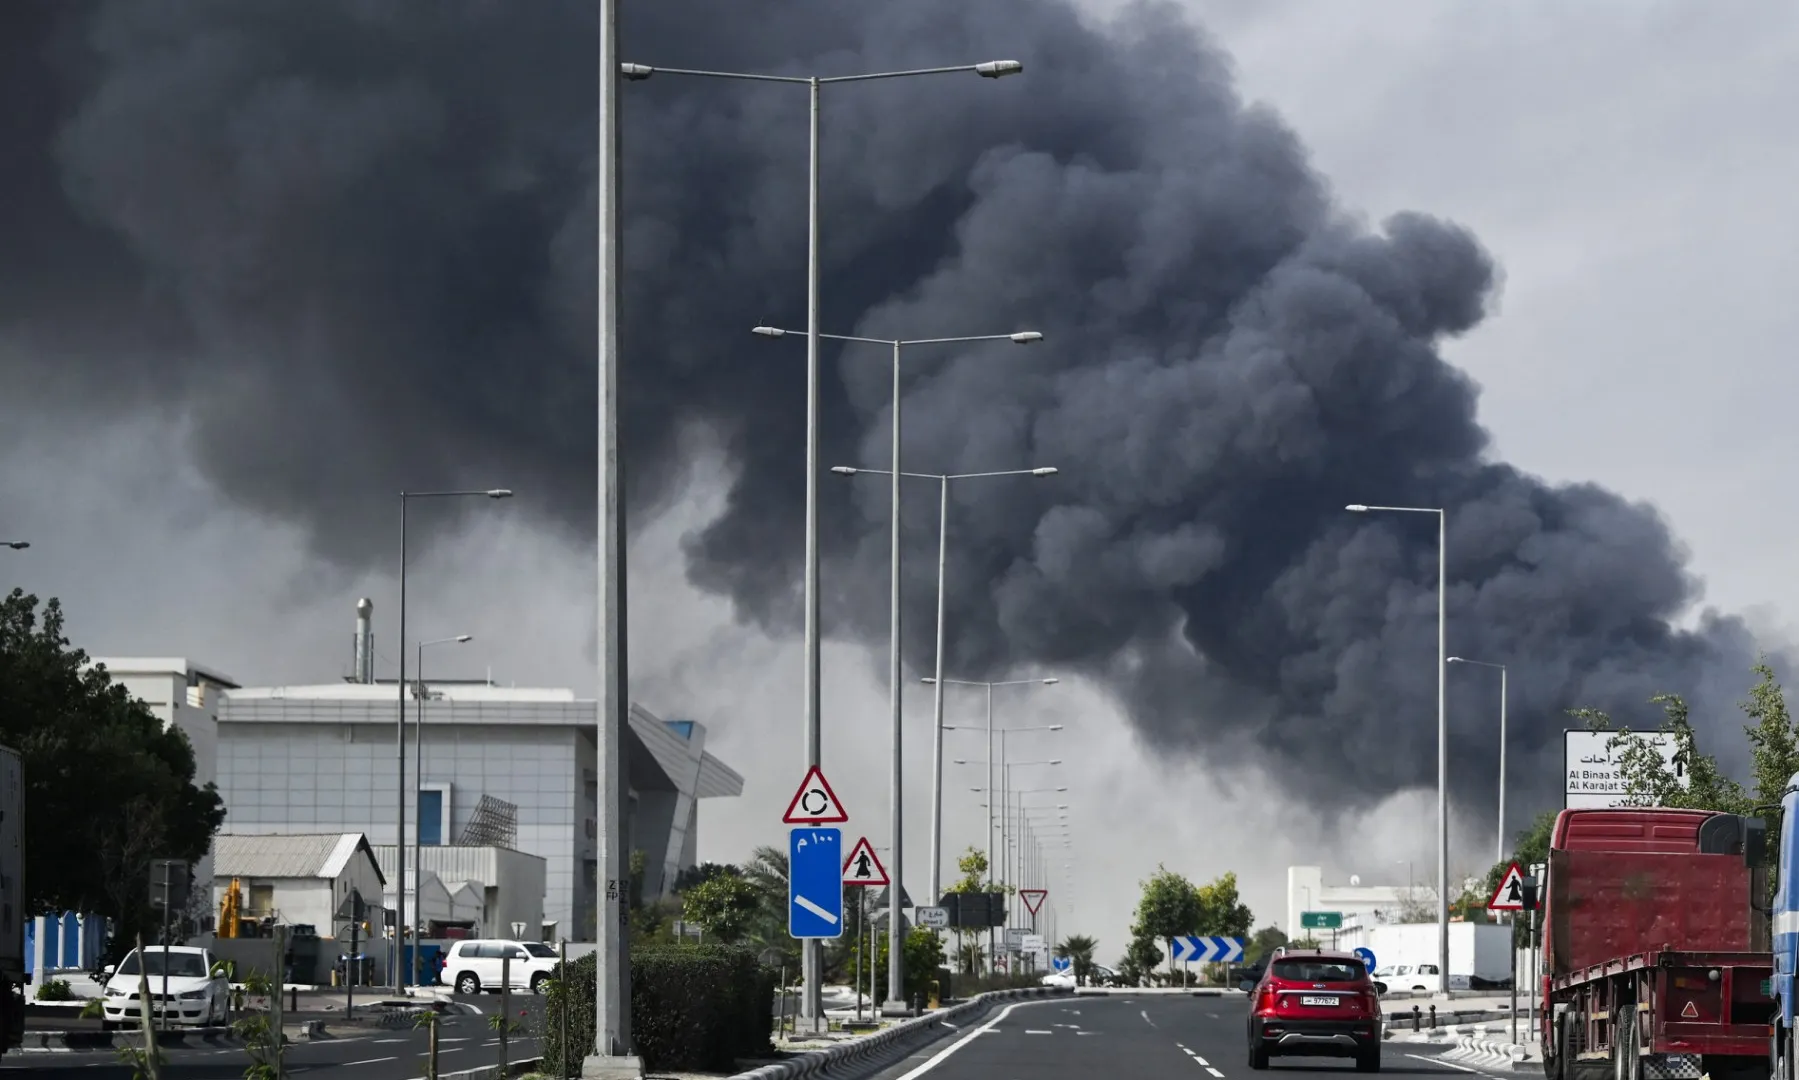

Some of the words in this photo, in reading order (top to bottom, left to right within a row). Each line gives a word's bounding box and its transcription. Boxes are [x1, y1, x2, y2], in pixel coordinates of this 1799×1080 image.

[1569, 770, 1579, 779] Al
[1582, 770, 1610, 780] Binaa
[1569, 781, 1579, 790] Al
[1582, 781, 1618, 791] Karajat
[812, 832, 833, 845] ١٠٠
[797, 838, 808, 854] م
[609, 880, 616, 890] Z
[606, 892, 618, 901] FP
[1313, 997, 1336, 1005] 977672
